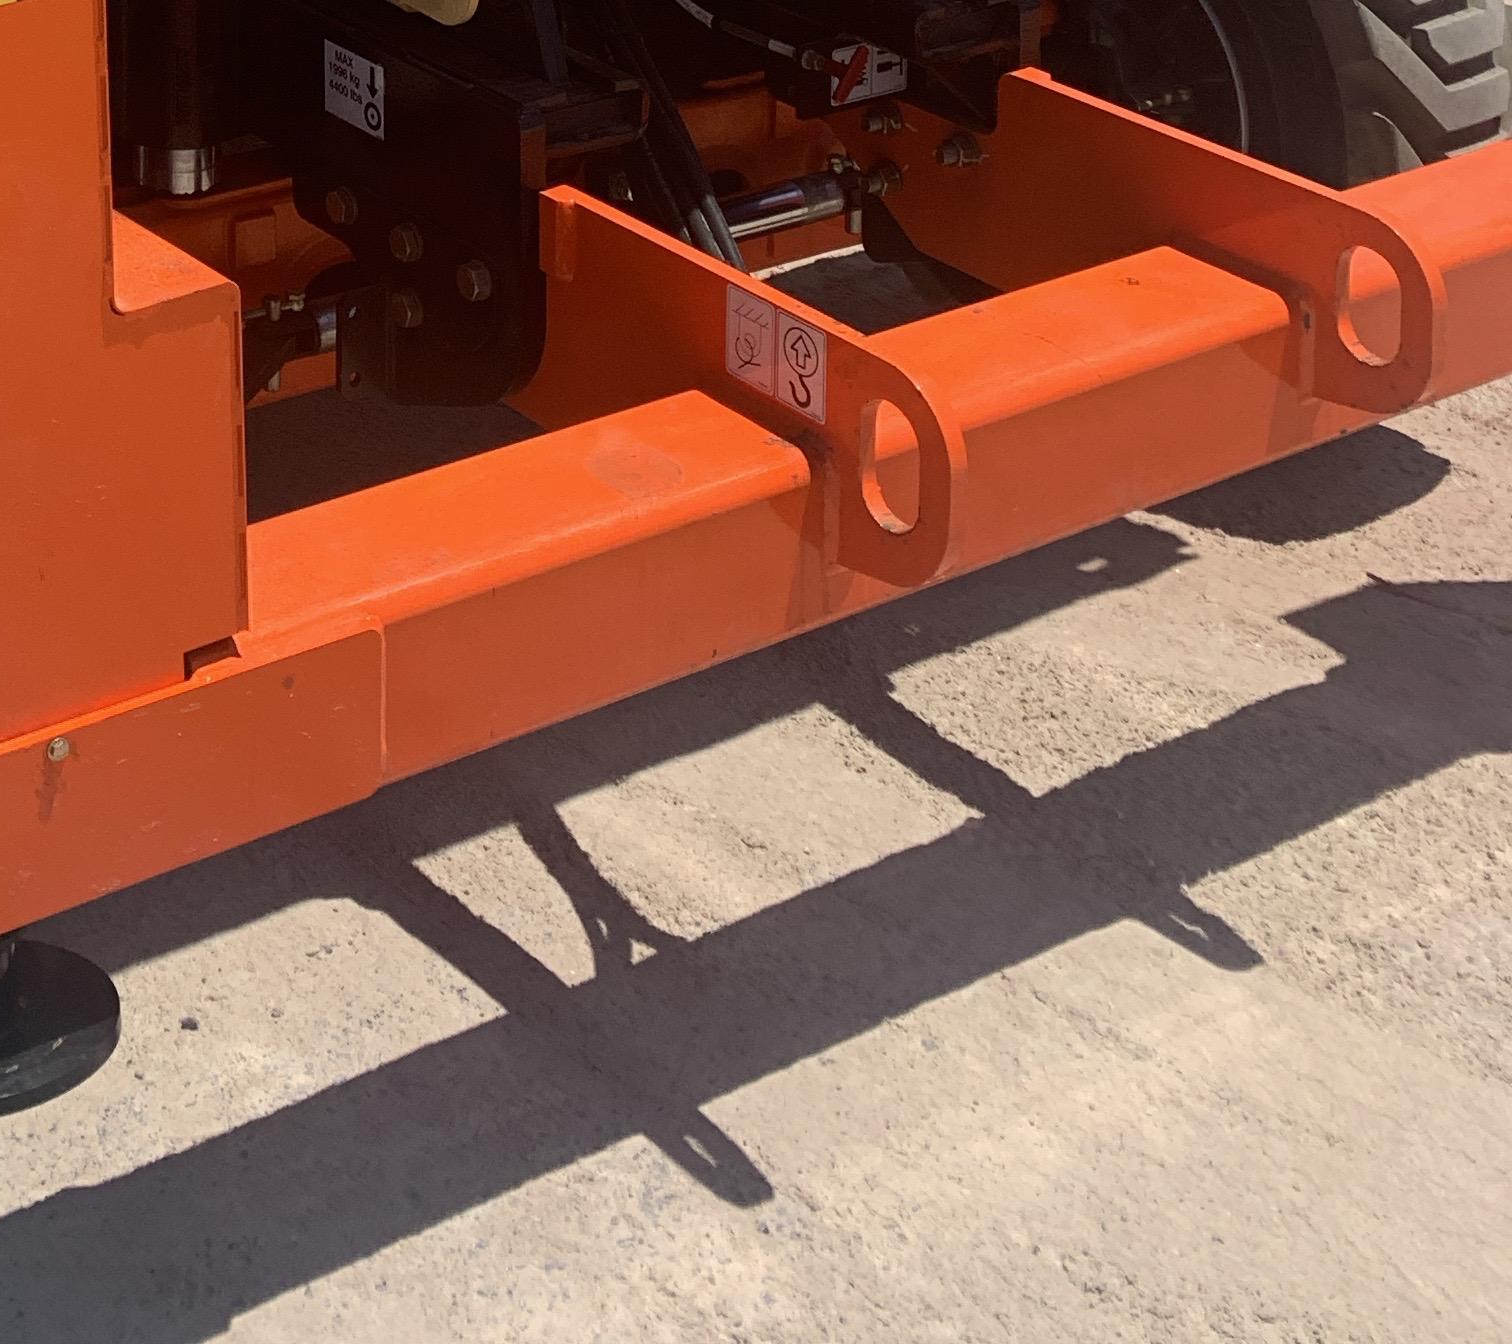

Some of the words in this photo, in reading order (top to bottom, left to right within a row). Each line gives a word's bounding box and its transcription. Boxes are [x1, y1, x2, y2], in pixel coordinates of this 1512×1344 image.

[335, 50, 353, 69] MAX
[350, 71, 360, 89] kg
[329, 80, 348, 97] 4400
[350, 89, 363, 105] lbs
